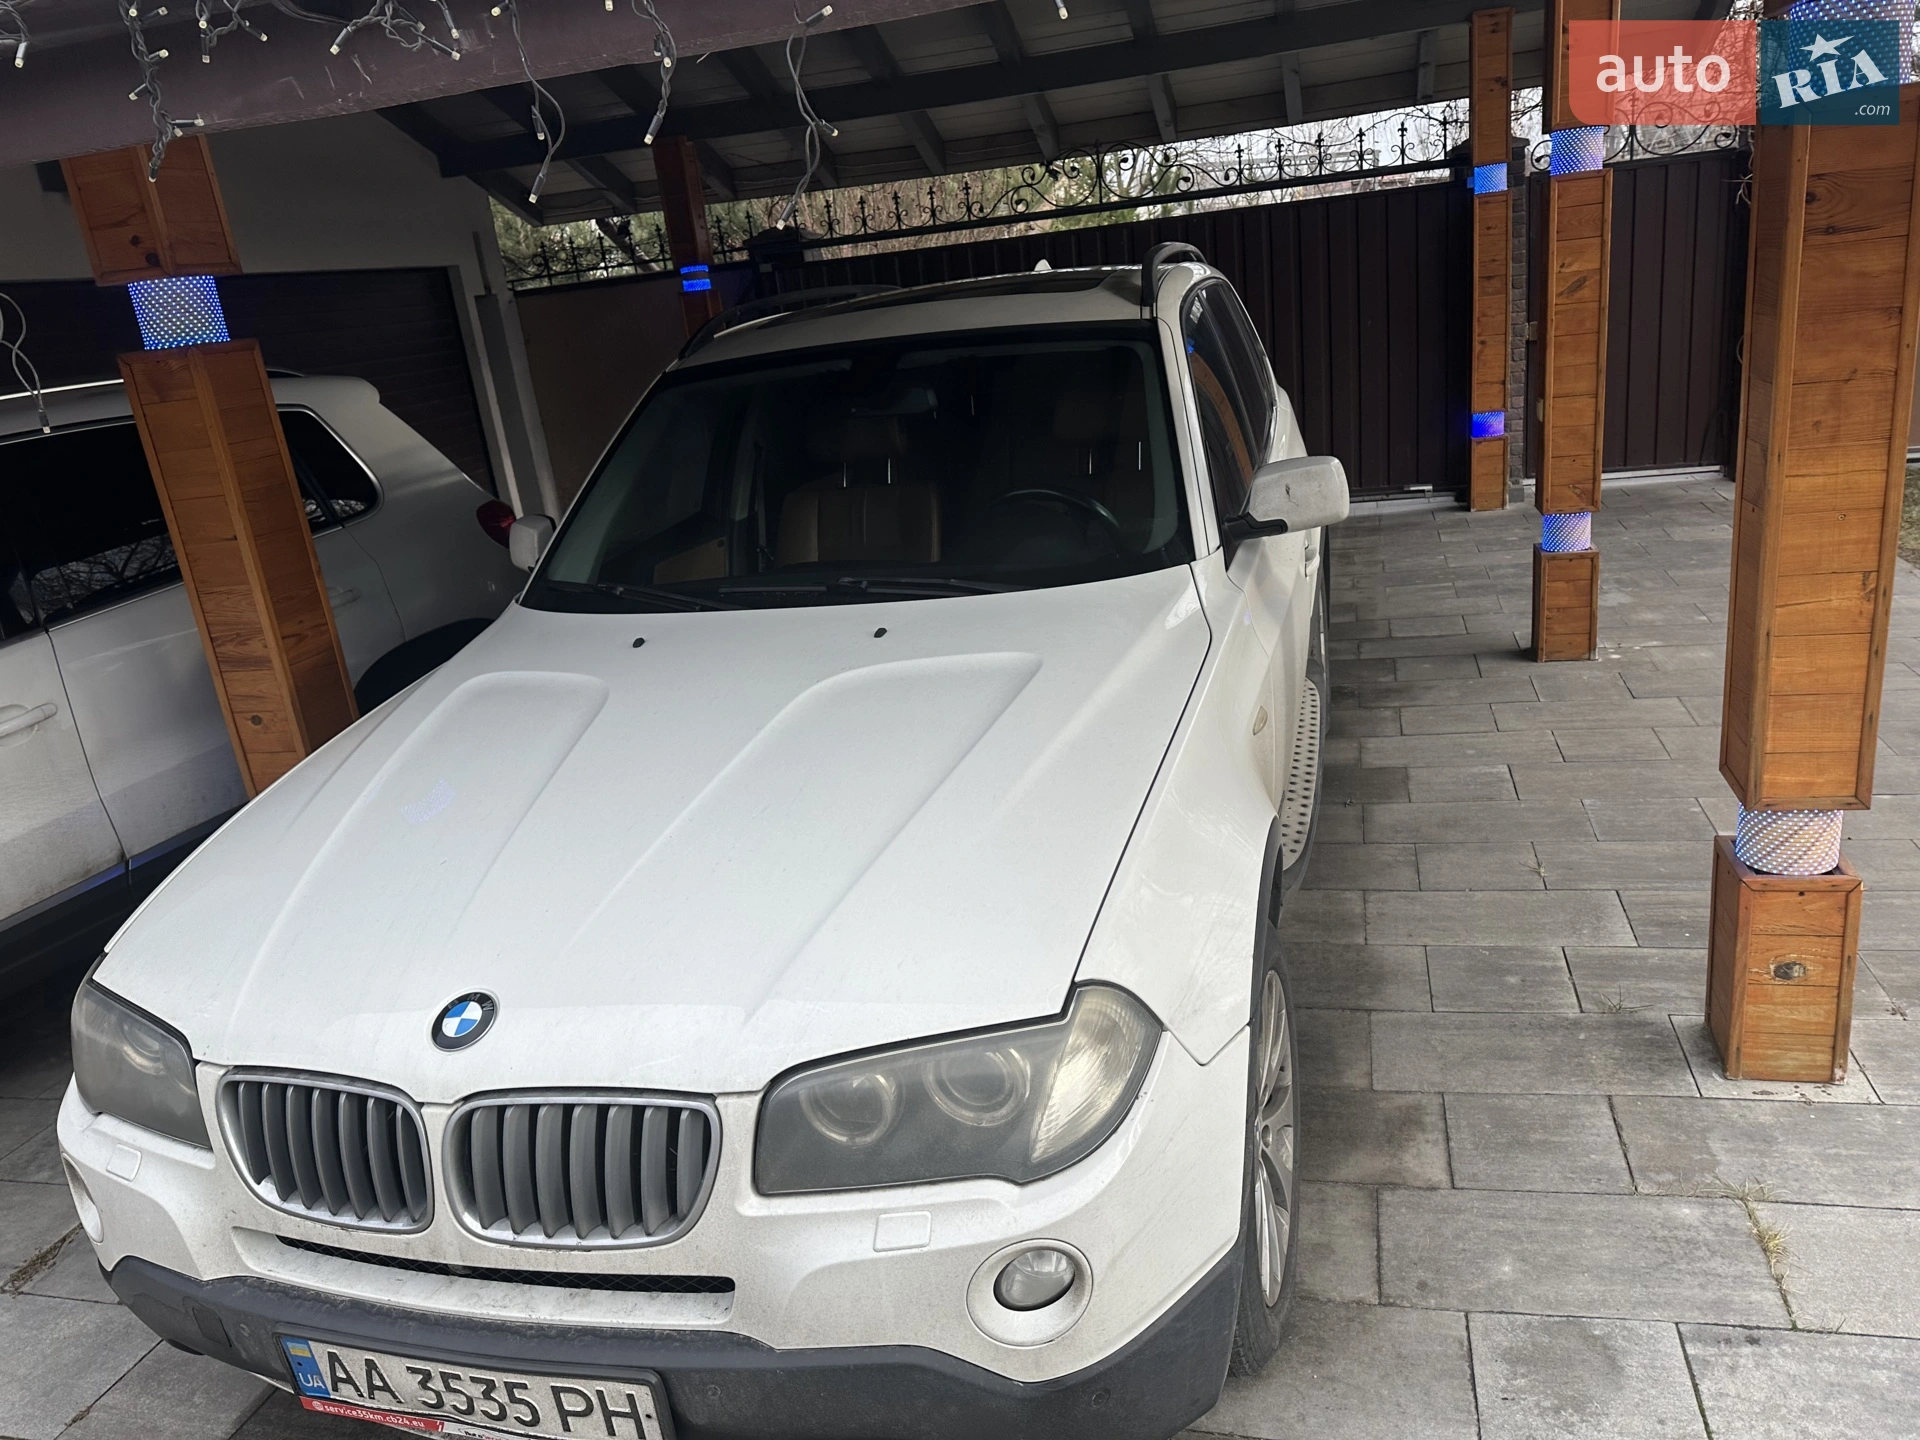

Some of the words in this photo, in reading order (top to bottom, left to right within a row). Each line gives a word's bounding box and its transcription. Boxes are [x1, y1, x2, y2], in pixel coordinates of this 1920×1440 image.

[299, 1373, 325, 1389] UA
[327, 1350, 404, 1404] AA
[405, 1365, 541, 1427] 3535
[550, 1384, 646, 1440] PH
